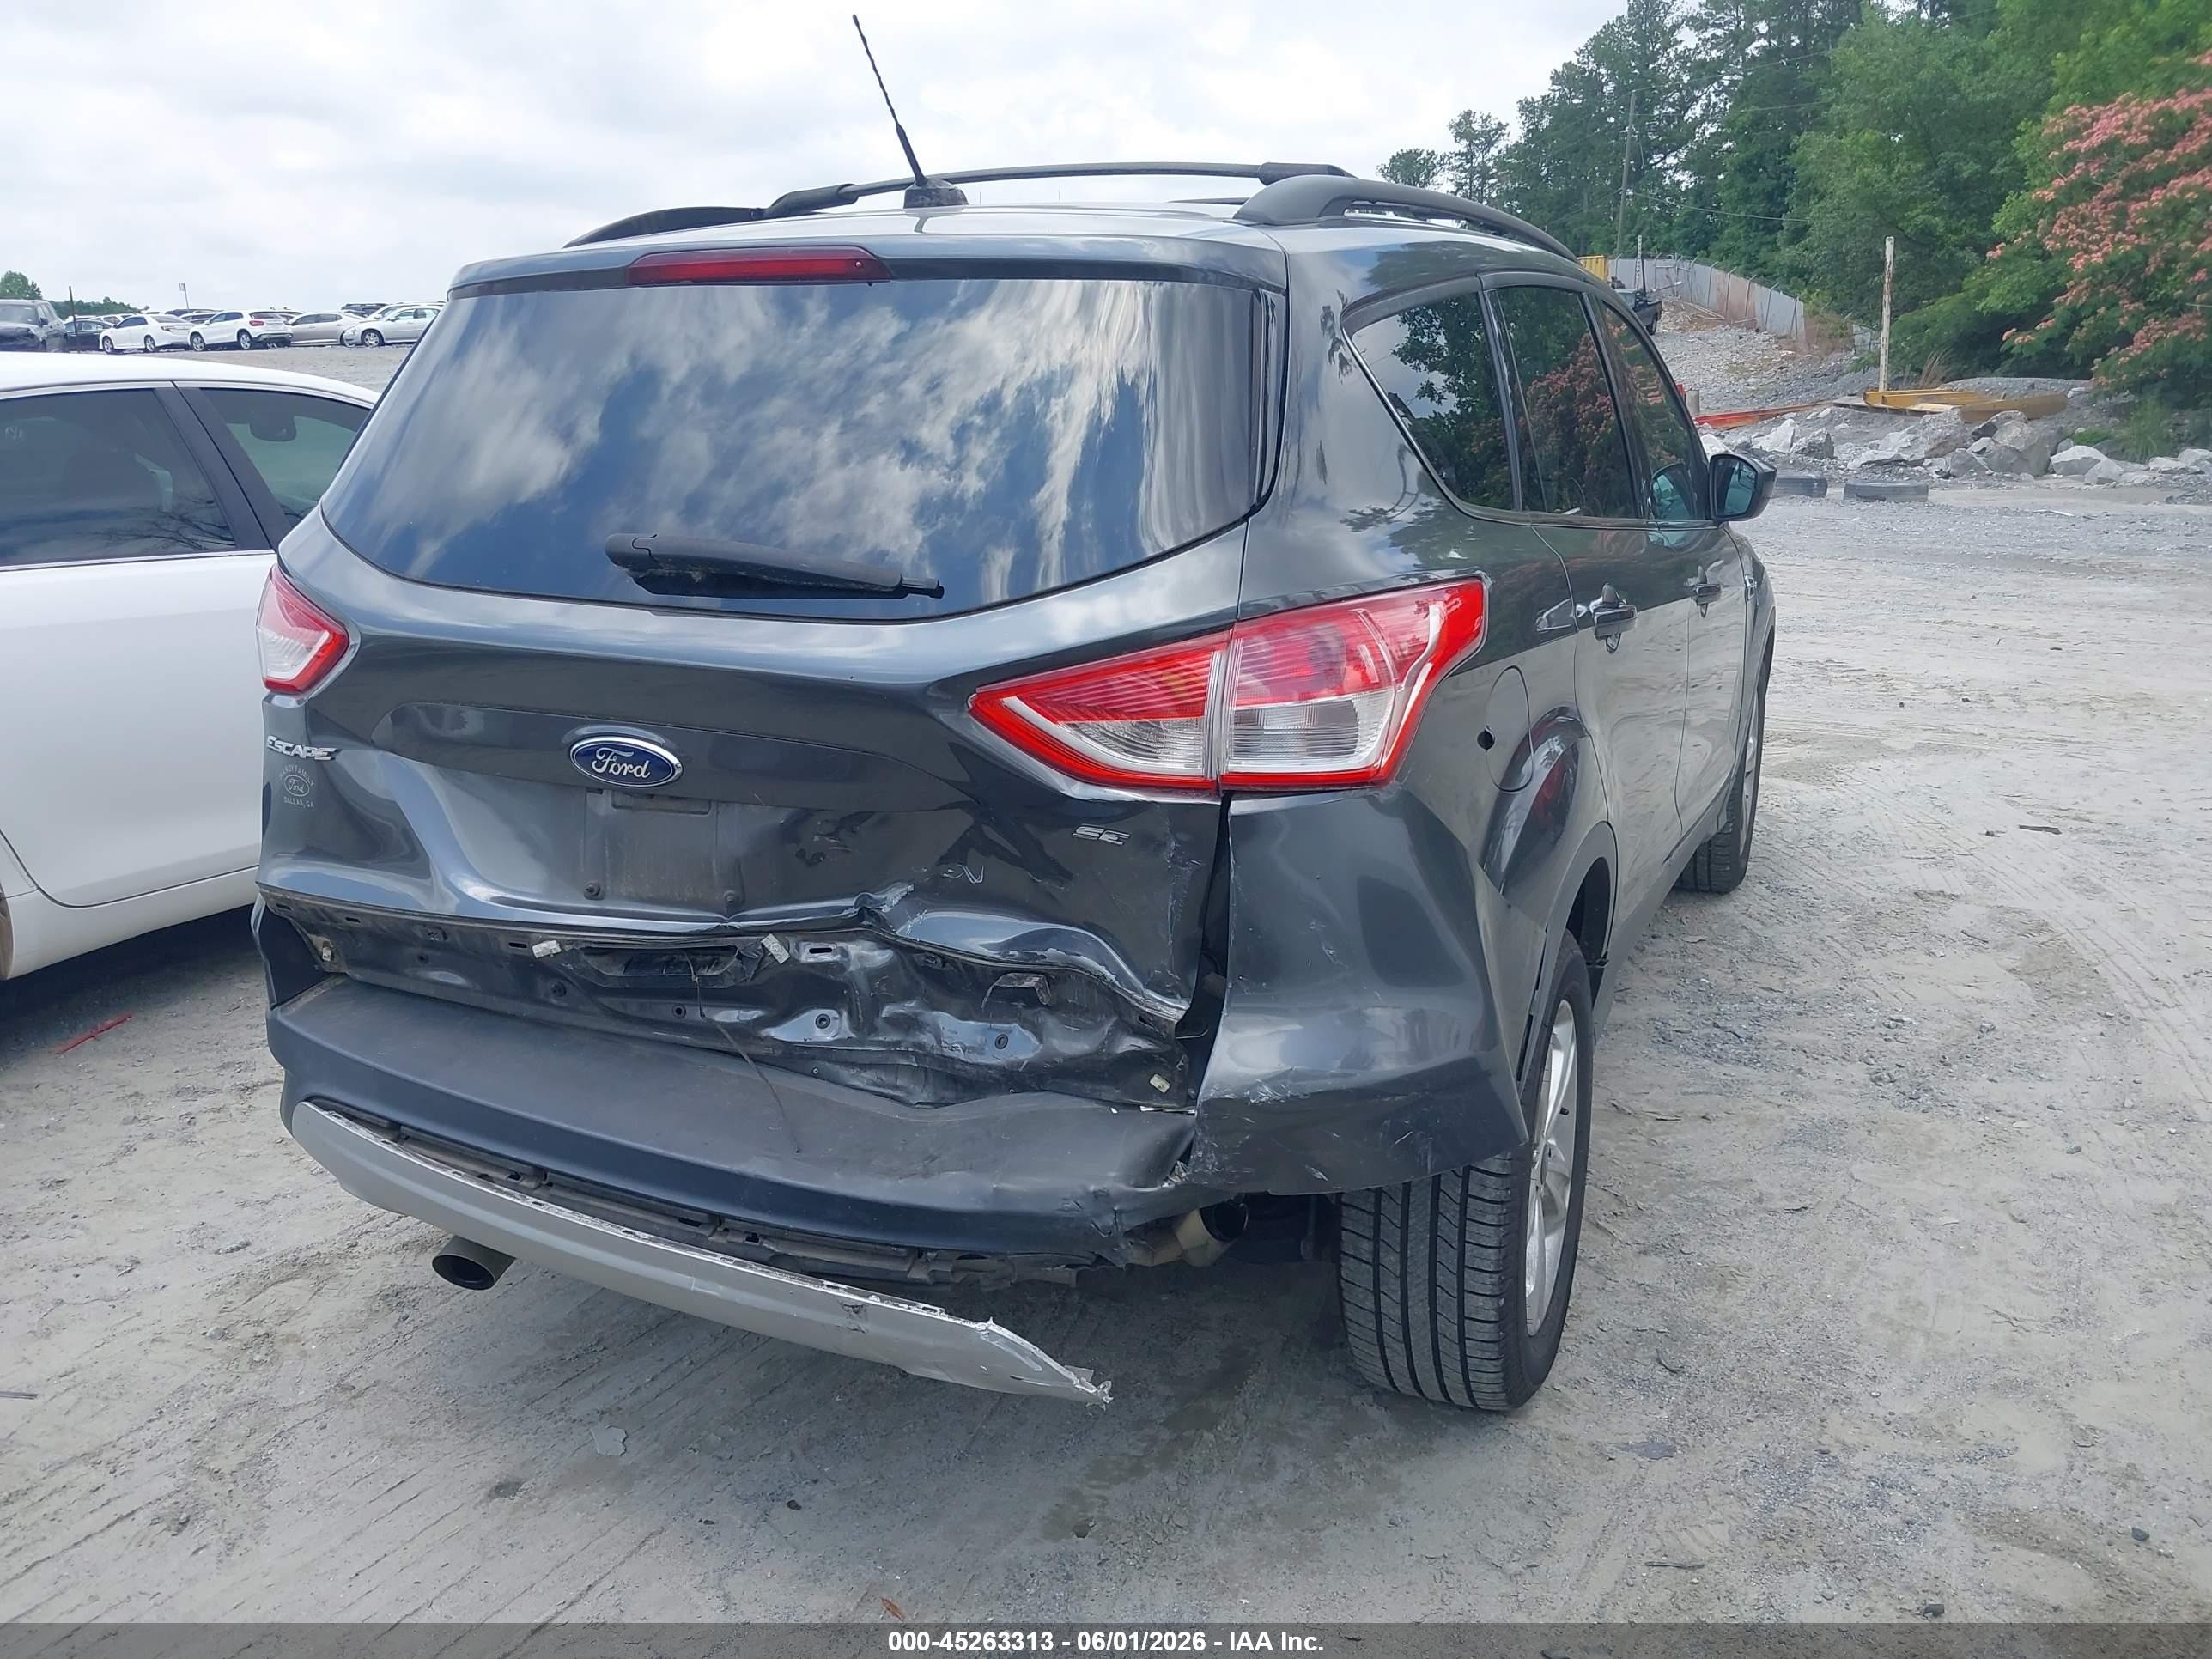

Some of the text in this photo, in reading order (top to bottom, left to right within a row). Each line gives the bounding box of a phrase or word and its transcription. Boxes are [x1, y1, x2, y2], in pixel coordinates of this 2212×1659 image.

[267, 735, 337, 761] ESCAPE
[592, 747, 651, 779] Ford
[288, 778, 305, 793] Ford
[1072, 826, 1130, 846] SE
